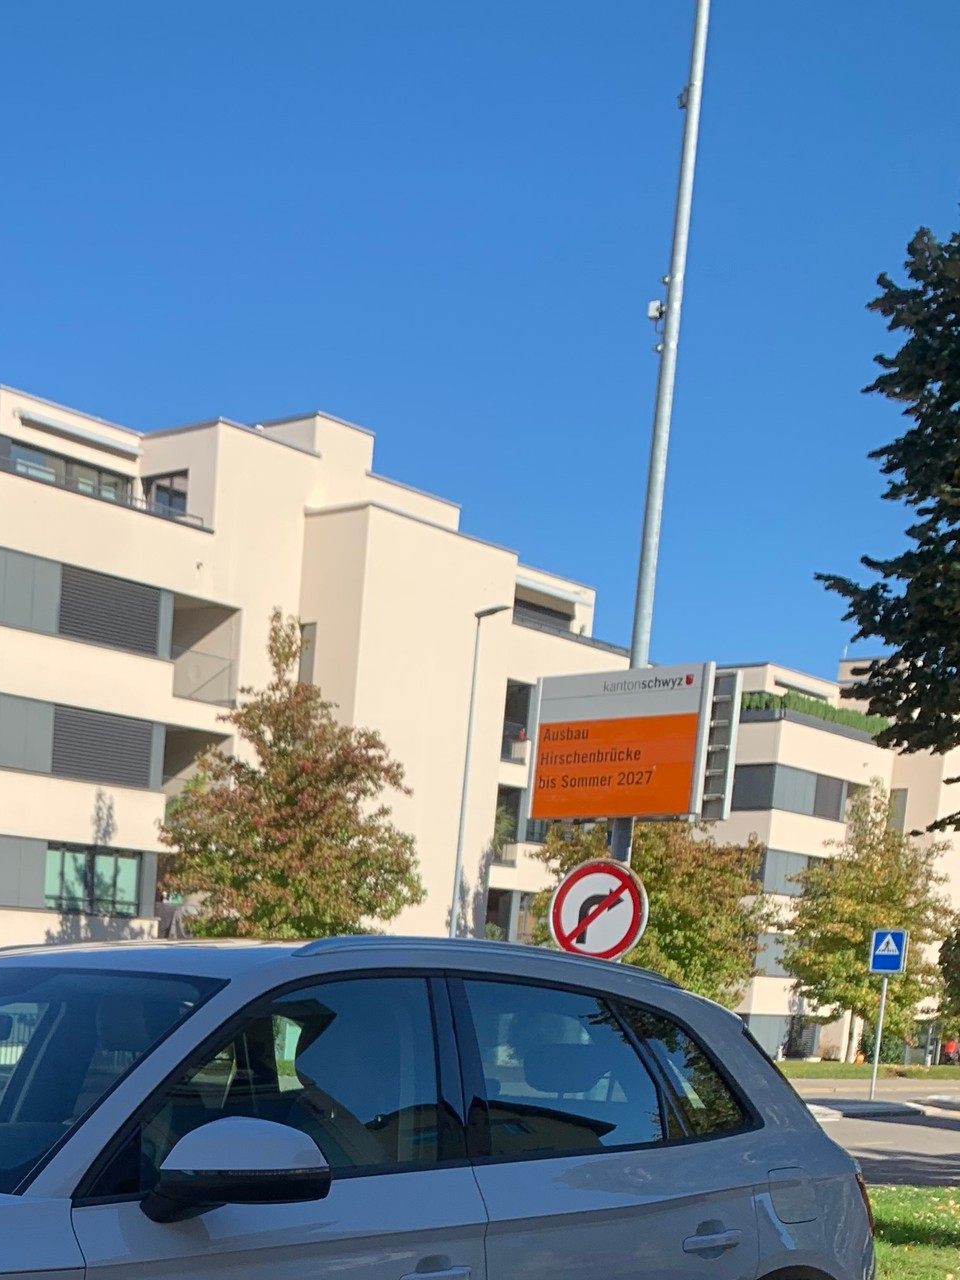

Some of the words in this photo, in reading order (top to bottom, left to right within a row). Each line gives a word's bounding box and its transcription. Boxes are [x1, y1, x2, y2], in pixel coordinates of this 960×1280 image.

[603, 675, 683, 692] kantonschwyz
[543, 727, 589, 742] Ausbau
[540, 748, 641, 765] Hirschenbrücke
[538, 775, 556, 789] bis
[561, 774, 613, 788] Sommer
[617, 771, 653, 786] 2027
